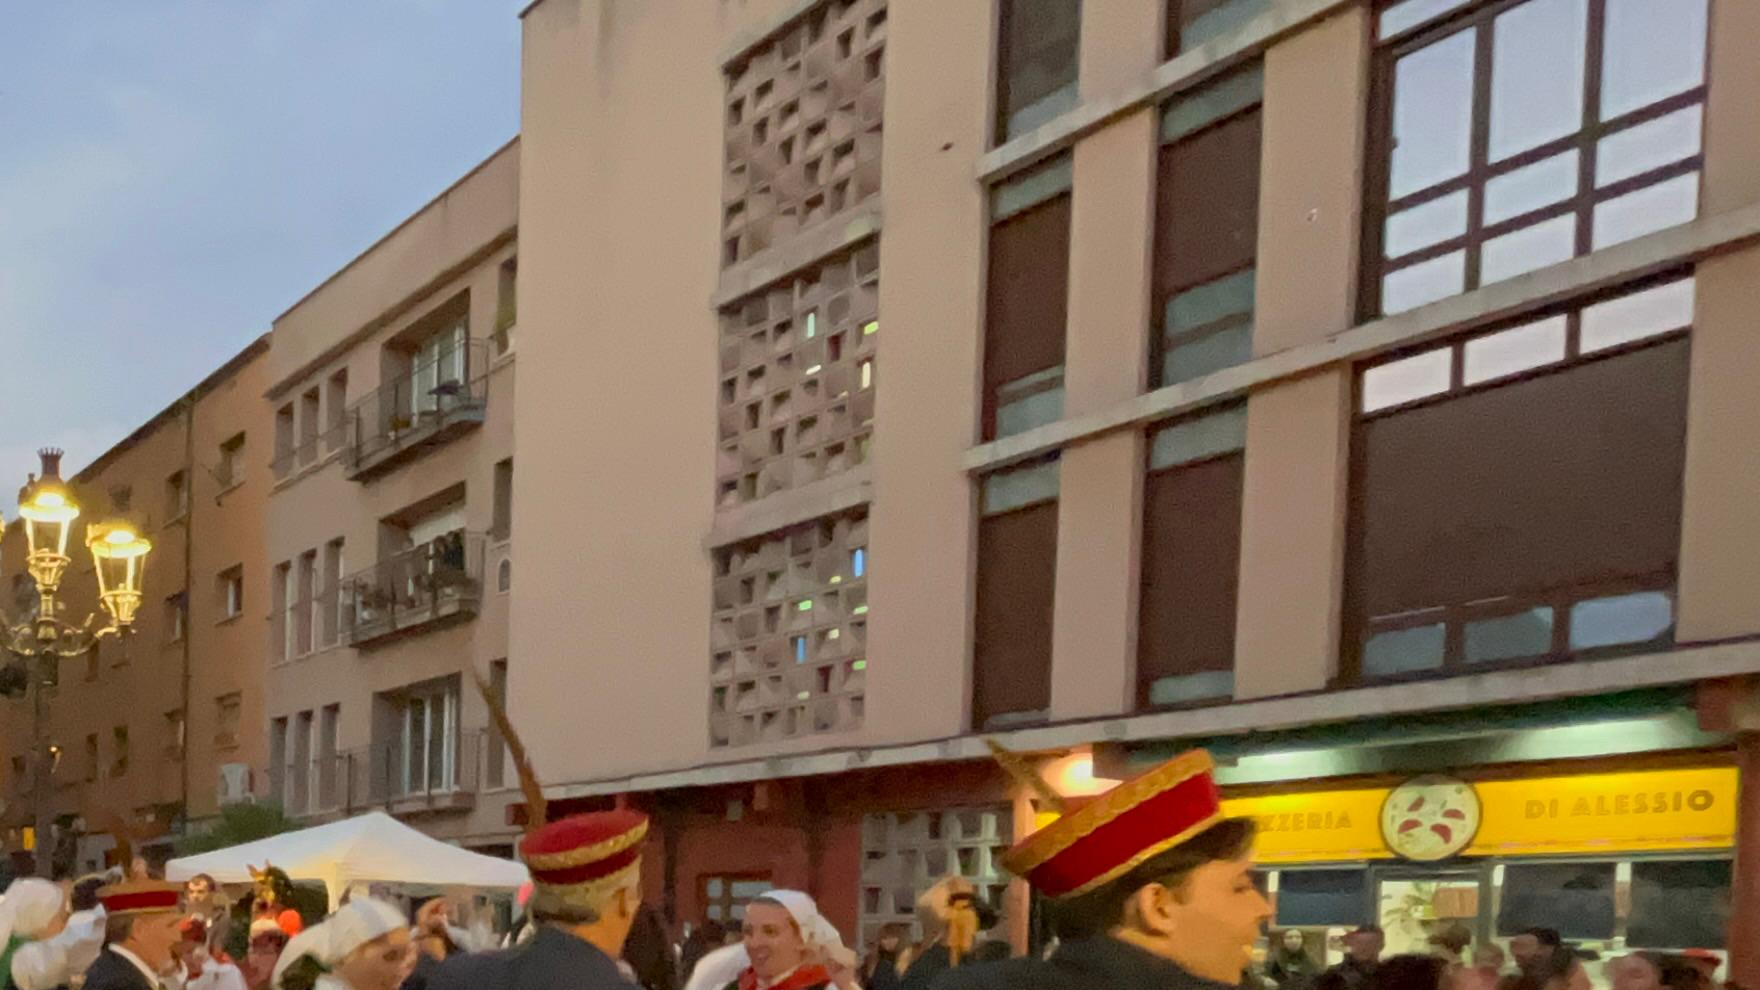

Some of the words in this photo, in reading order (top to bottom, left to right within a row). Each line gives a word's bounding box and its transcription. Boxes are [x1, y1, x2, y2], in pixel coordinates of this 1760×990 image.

[1260, 811, 1352, 832] ZZERIA
[1525, 799, 1559, 819] DI
[1570, 789, 1714, 817] ALESSIO
